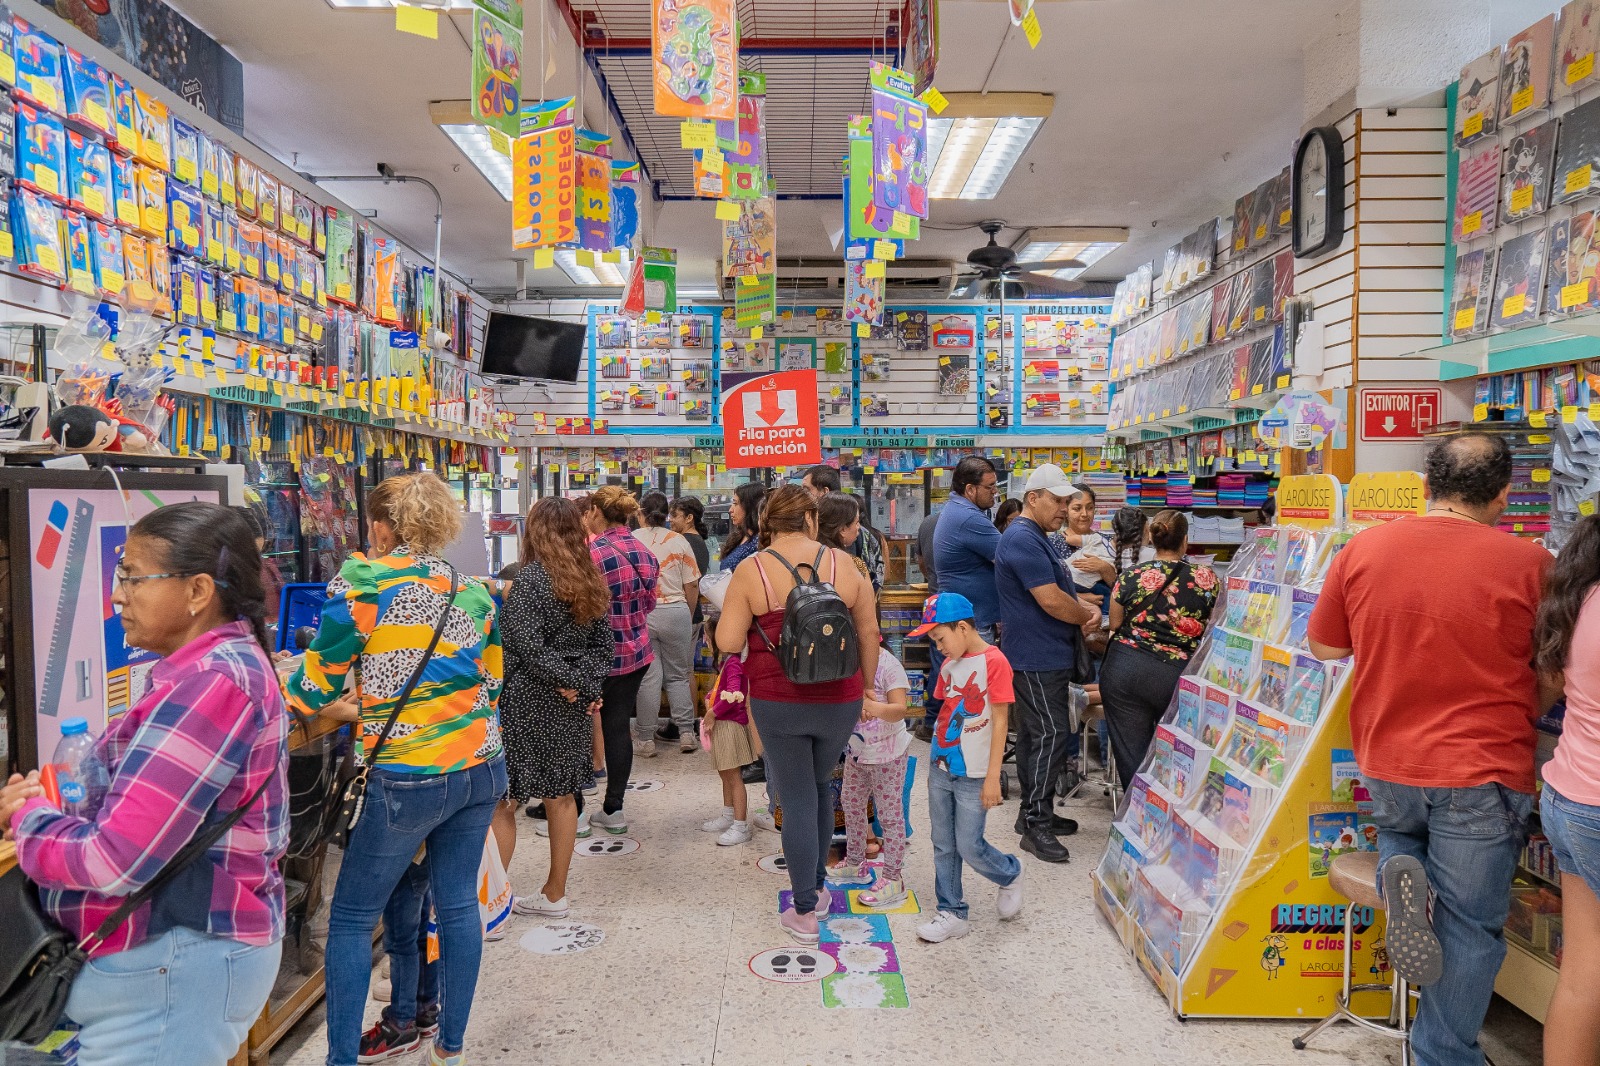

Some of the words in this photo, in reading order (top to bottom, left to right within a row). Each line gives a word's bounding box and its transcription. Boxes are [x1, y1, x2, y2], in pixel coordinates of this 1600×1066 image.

[184, 82, 199, 93] ROUTE
[1028, 305, 1104, 315] MARCATEXTOS
[977, 332, 985, 428] GLITTER
[1366, 394, 1411, 411] EXTINTOR
[739, 427, 764, 441] Fila
[768, 426, 806, 441] para
[738, 440, 807, 457] atención
[841, 439, 857, 447] 477
[865, 439, 883, 447] 405
[888, 439, 900, 447] 94
[904, 439, 914, 447] 72
[935, 438, 948, 447] sin
[1280, 488, 1330, 507] LAROUSSE
[1352, 487, 1419, 509] LAROUSSE
[62, 786, 82, 798] ciel
[1273, 904, 1375, 930] REGRESO
[1303, 940, 1312, 951] a
[1315, 936, 1362, 951] class
[1300, 962, 1357, 972] LAROUSE
